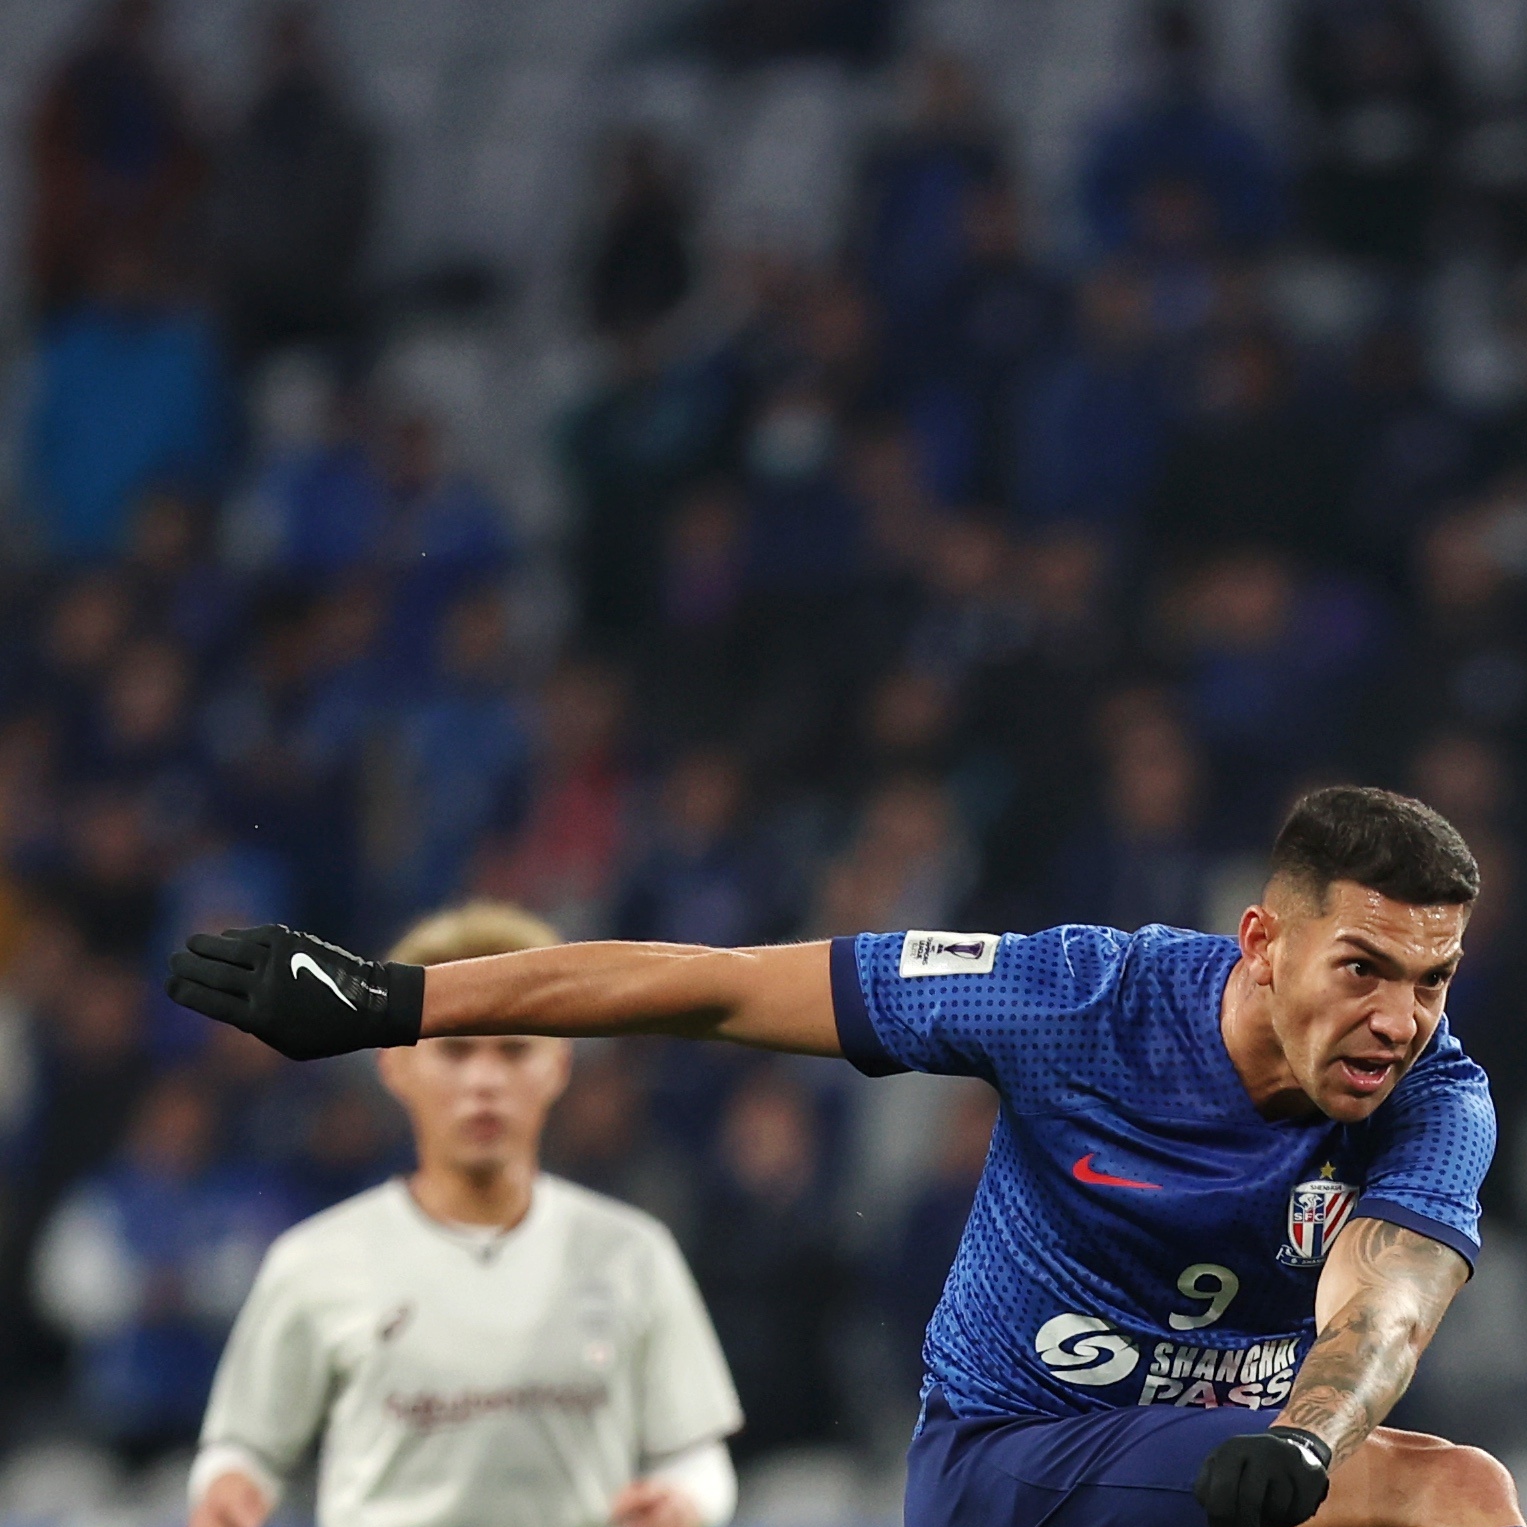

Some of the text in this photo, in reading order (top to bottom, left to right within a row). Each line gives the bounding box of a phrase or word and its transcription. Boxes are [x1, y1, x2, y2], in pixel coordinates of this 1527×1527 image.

[1293, 1212, 1324, 1222] SFC
[1168, 1263, 1240, 1331] 9
[1150, 1337, 1301, 1384] SHANGHAI
